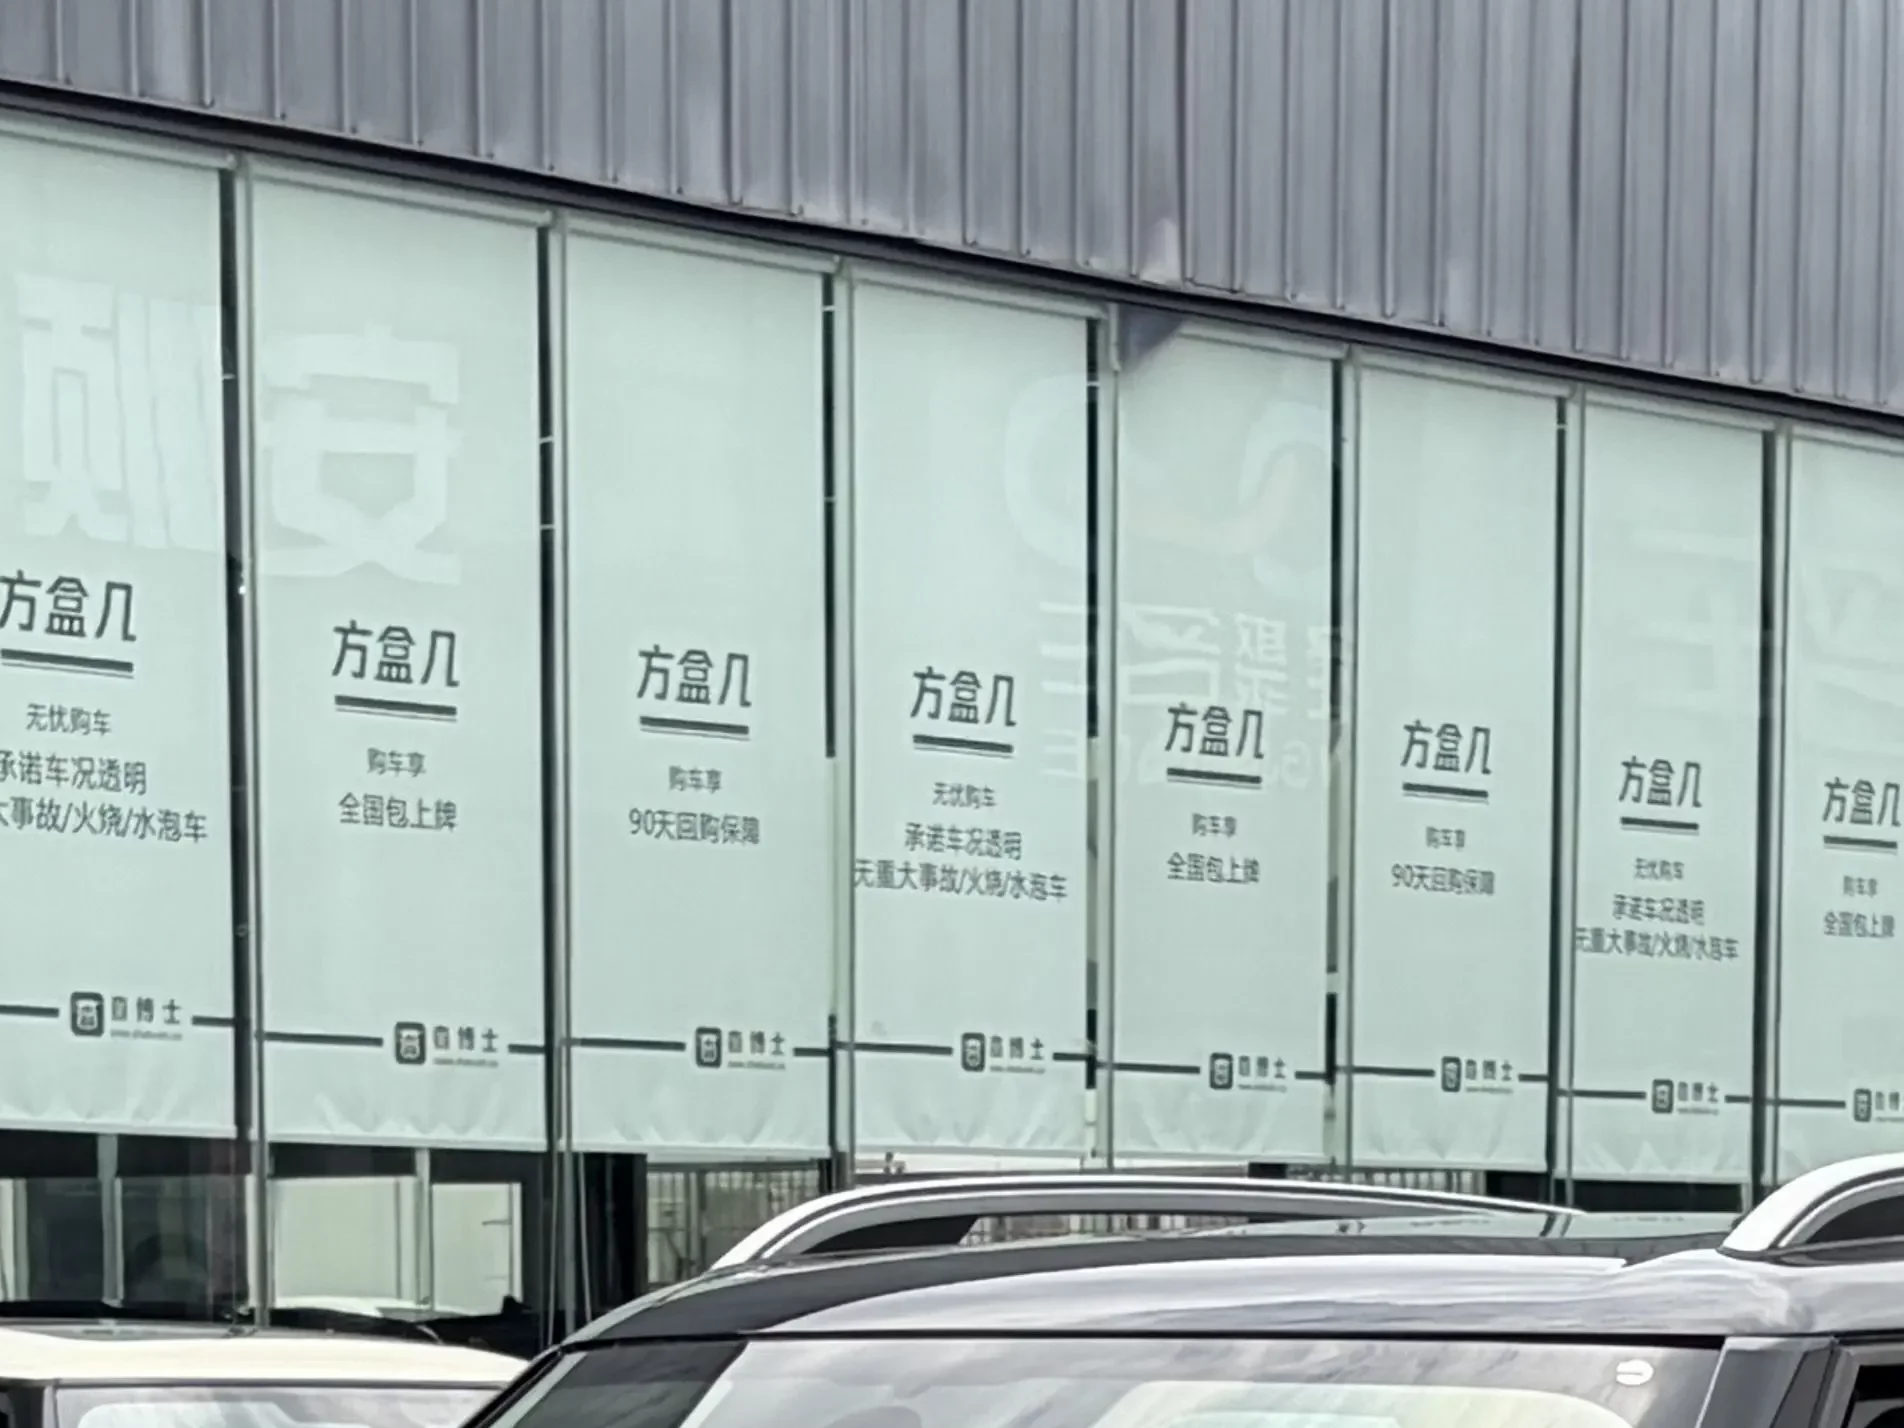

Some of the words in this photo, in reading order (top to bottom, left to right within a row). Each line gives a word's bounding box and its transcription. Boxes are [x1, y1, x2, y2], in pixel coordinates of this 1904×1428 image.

[331, 619, 460, 688] 方盒几
[636, 643, 753, 708] 方盒几
[909, 665, 1017, 728] 方盒几
[1164, 701, 1265, 760] 方盒几
[1399, 719, 1492, 776] 方盒几
[1618, 755, 1703, 809] 方盒几
[1822, 776, 1902, 828] 方盒几
[338, 791, 458, 832] 全国包上牌
